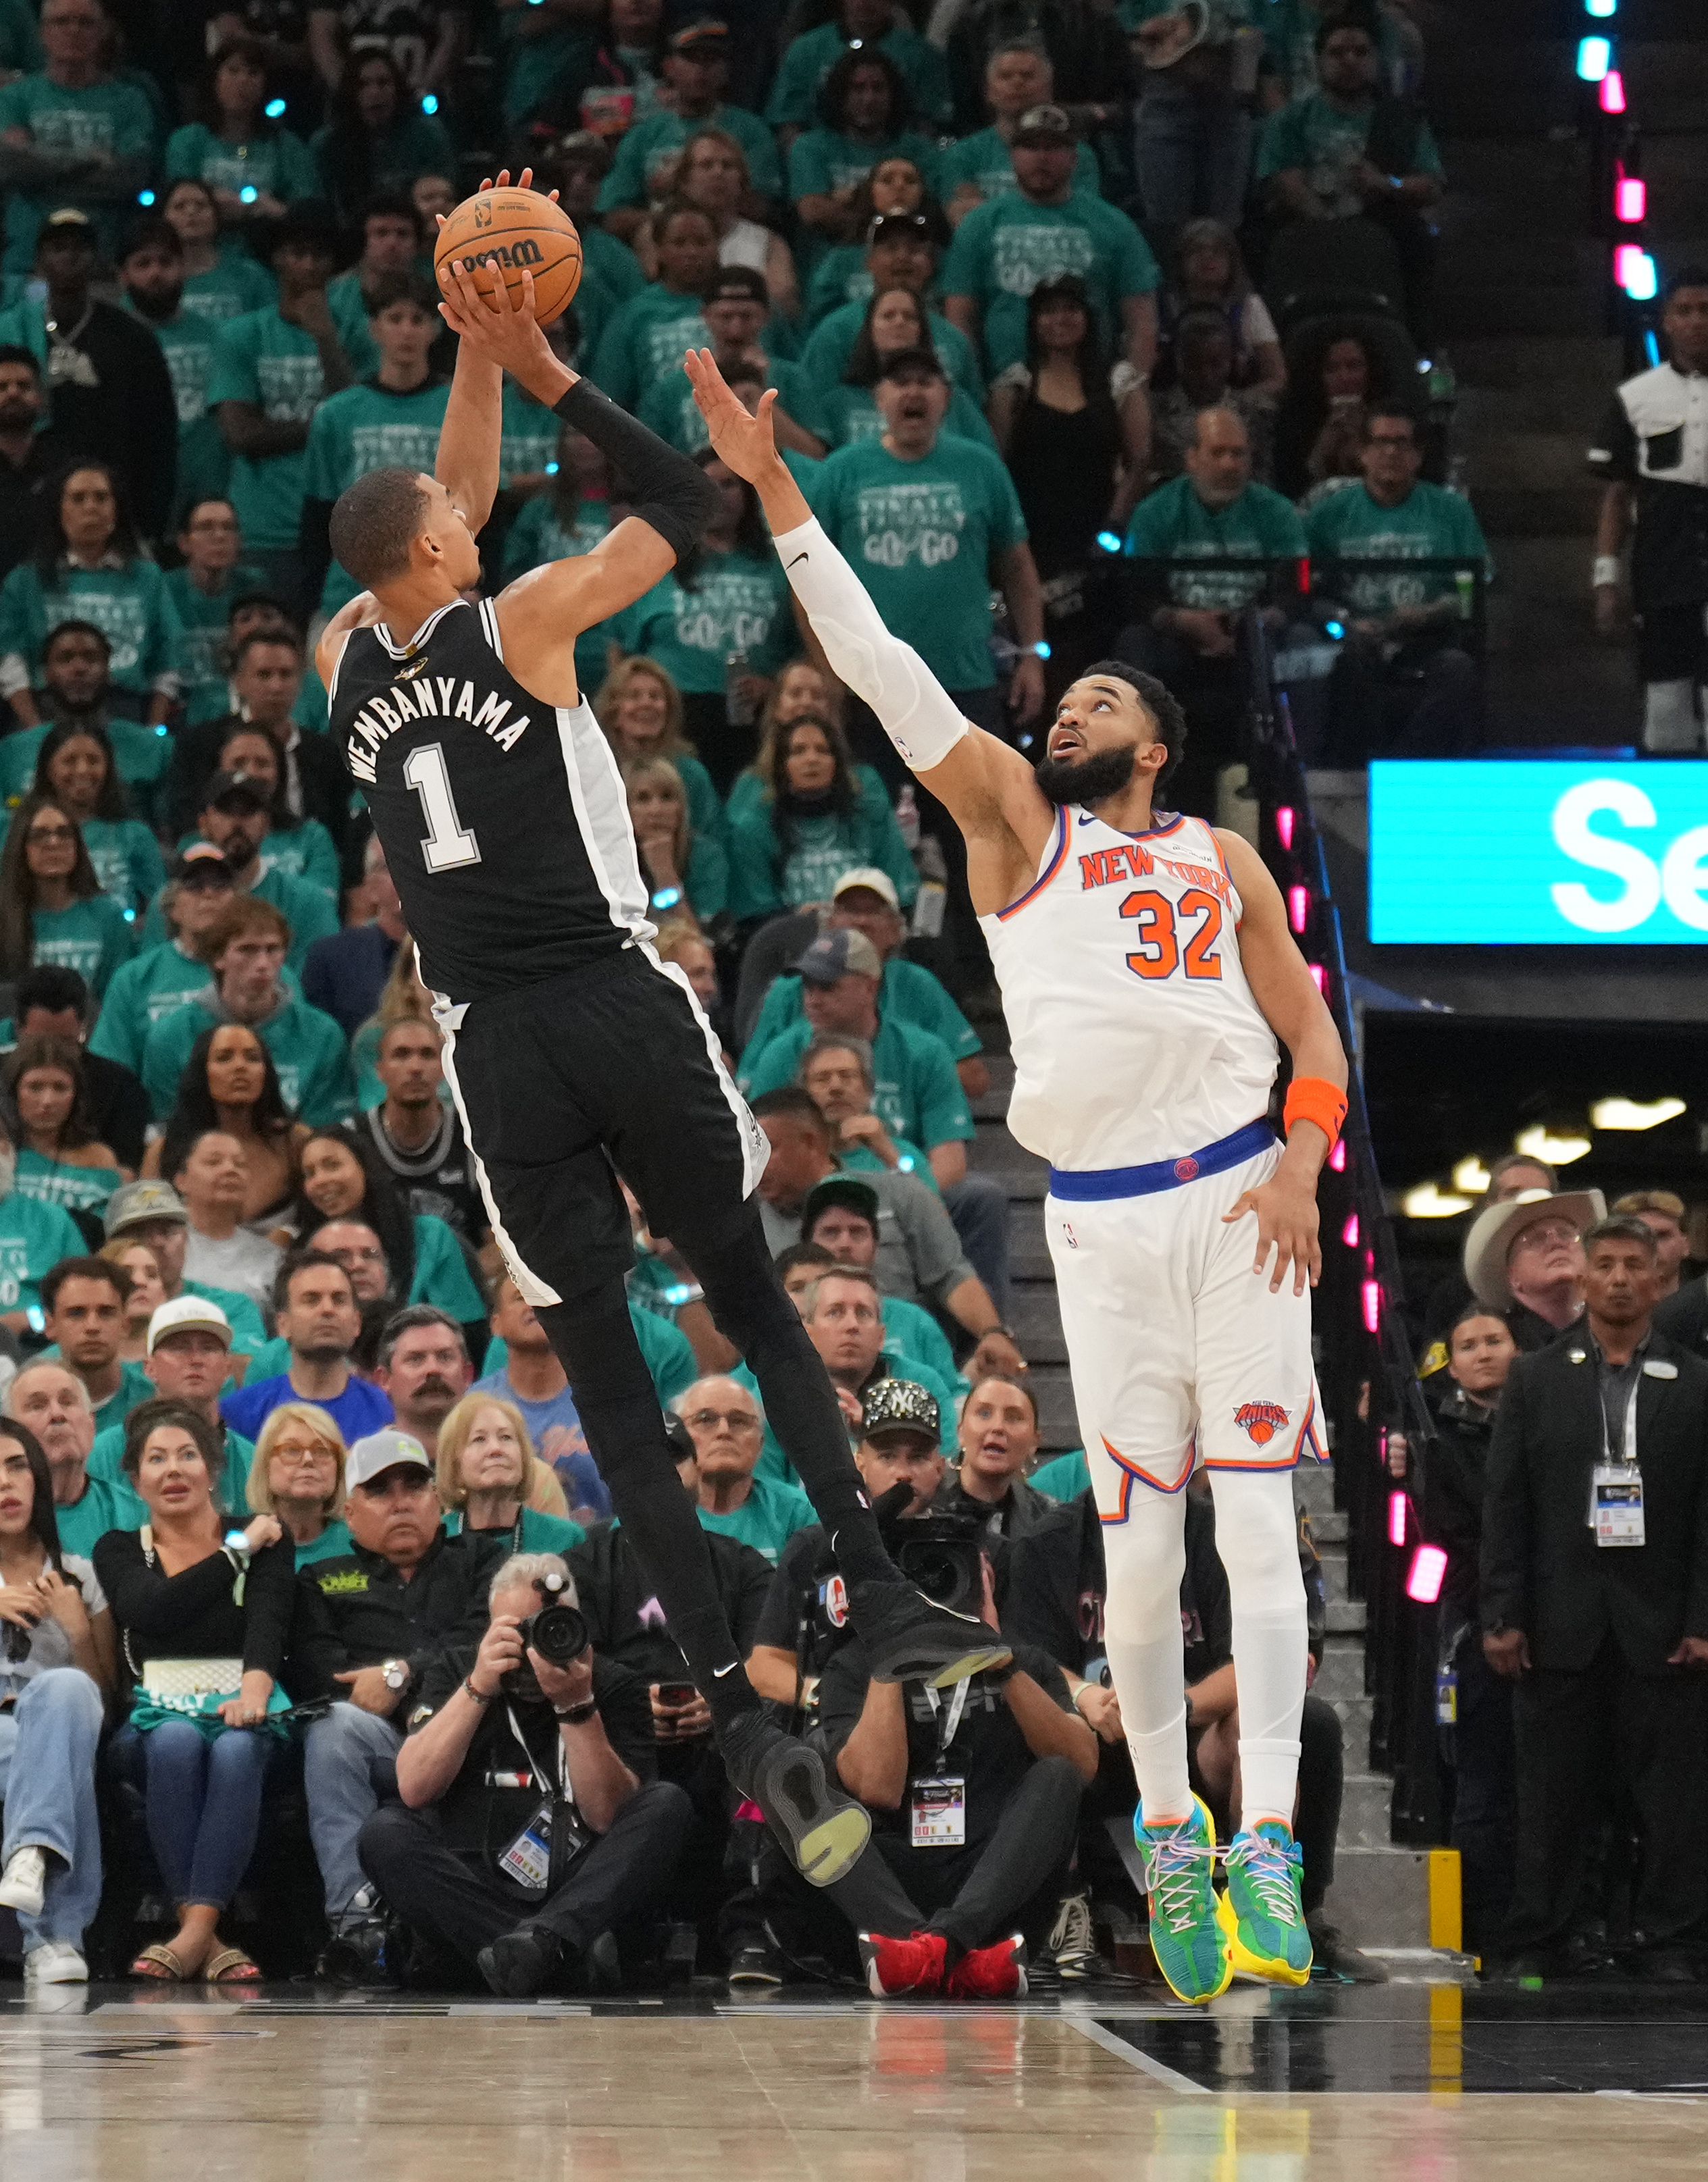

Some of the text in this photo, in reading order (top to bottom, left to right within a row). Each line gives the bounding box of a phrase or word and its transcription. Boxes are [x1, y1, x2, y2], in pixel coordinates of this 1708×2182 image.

[347, 676, 531, 784] WEMBANYAMA
[403, 742, 482, 875] 1
[1078, 844, 1156, 891] NEW
[1154, 854, 1233, 911] YORK
[1118, 888, 1223, 981] 32
[891, 1388, 914, 1413] NY
[1234, 1403, 1289, 1427] KNICKS
